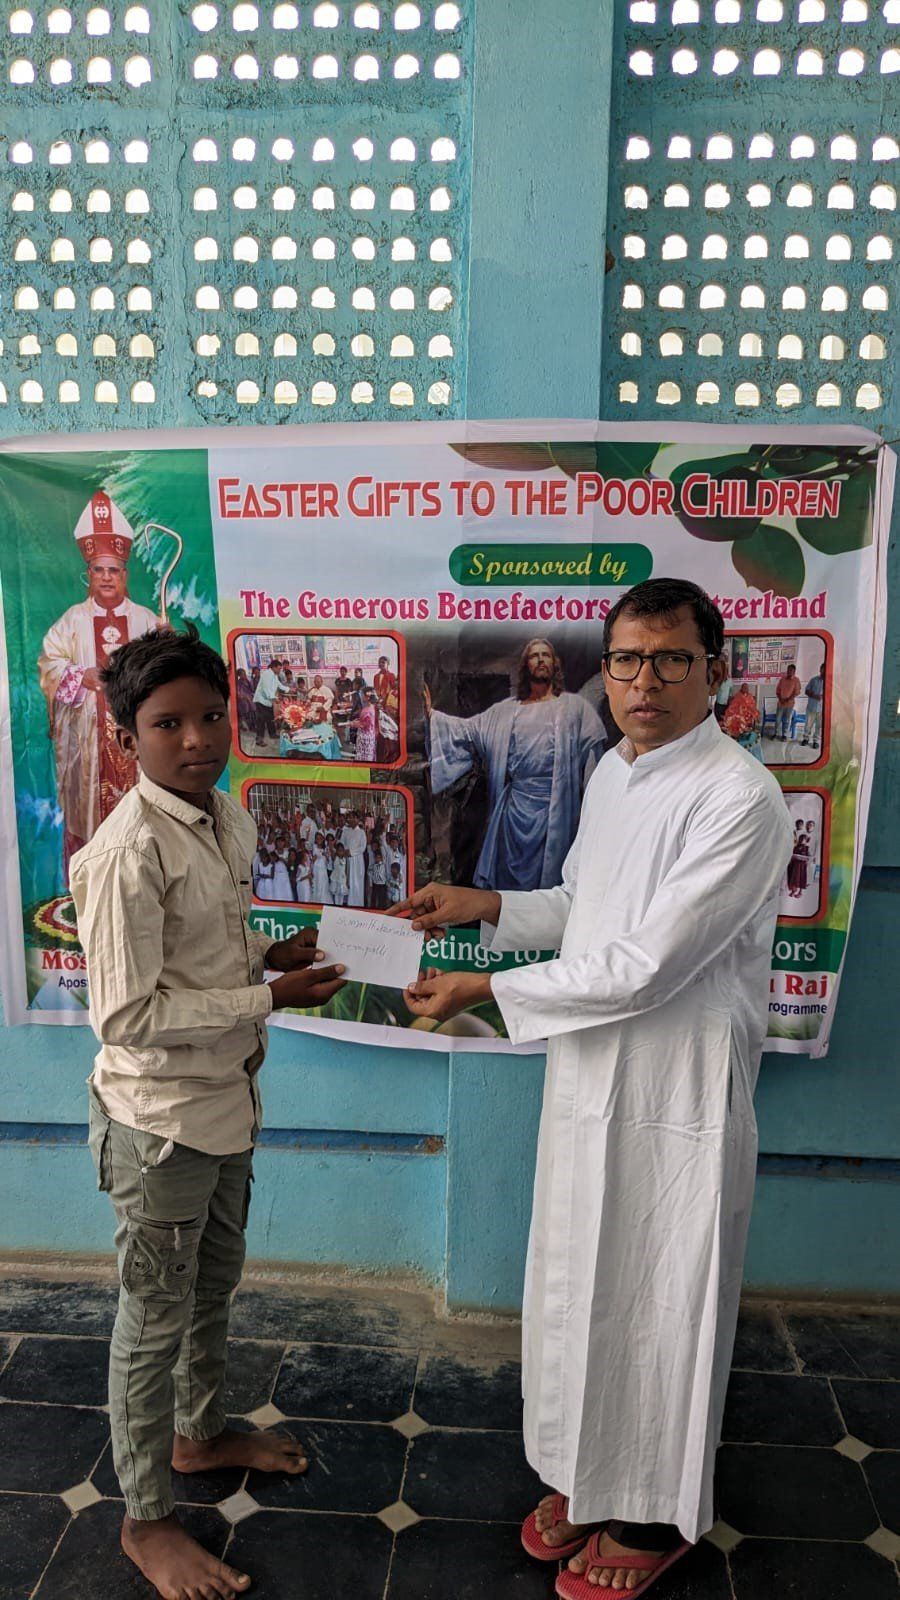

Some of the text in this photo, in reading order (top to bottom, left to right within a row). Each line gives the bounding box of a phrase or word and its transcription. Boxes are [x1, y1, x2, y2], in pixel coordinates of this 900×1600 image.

[217, 472, 842, 519] EASTER GIFTS TO THE POOR CHILDREN
[469, 552, 629, 583] Sponsored by
[240, 590, 828, 621] The Generous Benefactors tzerland
[253, 916, 321, 941] Tha
[420, 934, 504, 968] etings
[771, 940, 817, 962] ors
[42, 950, 87, 970] Mos
[58, 976, 89, 990] Apos
[784, 973, 828, 999] Raj
[768, 1001, 828, 1016] rogramme
